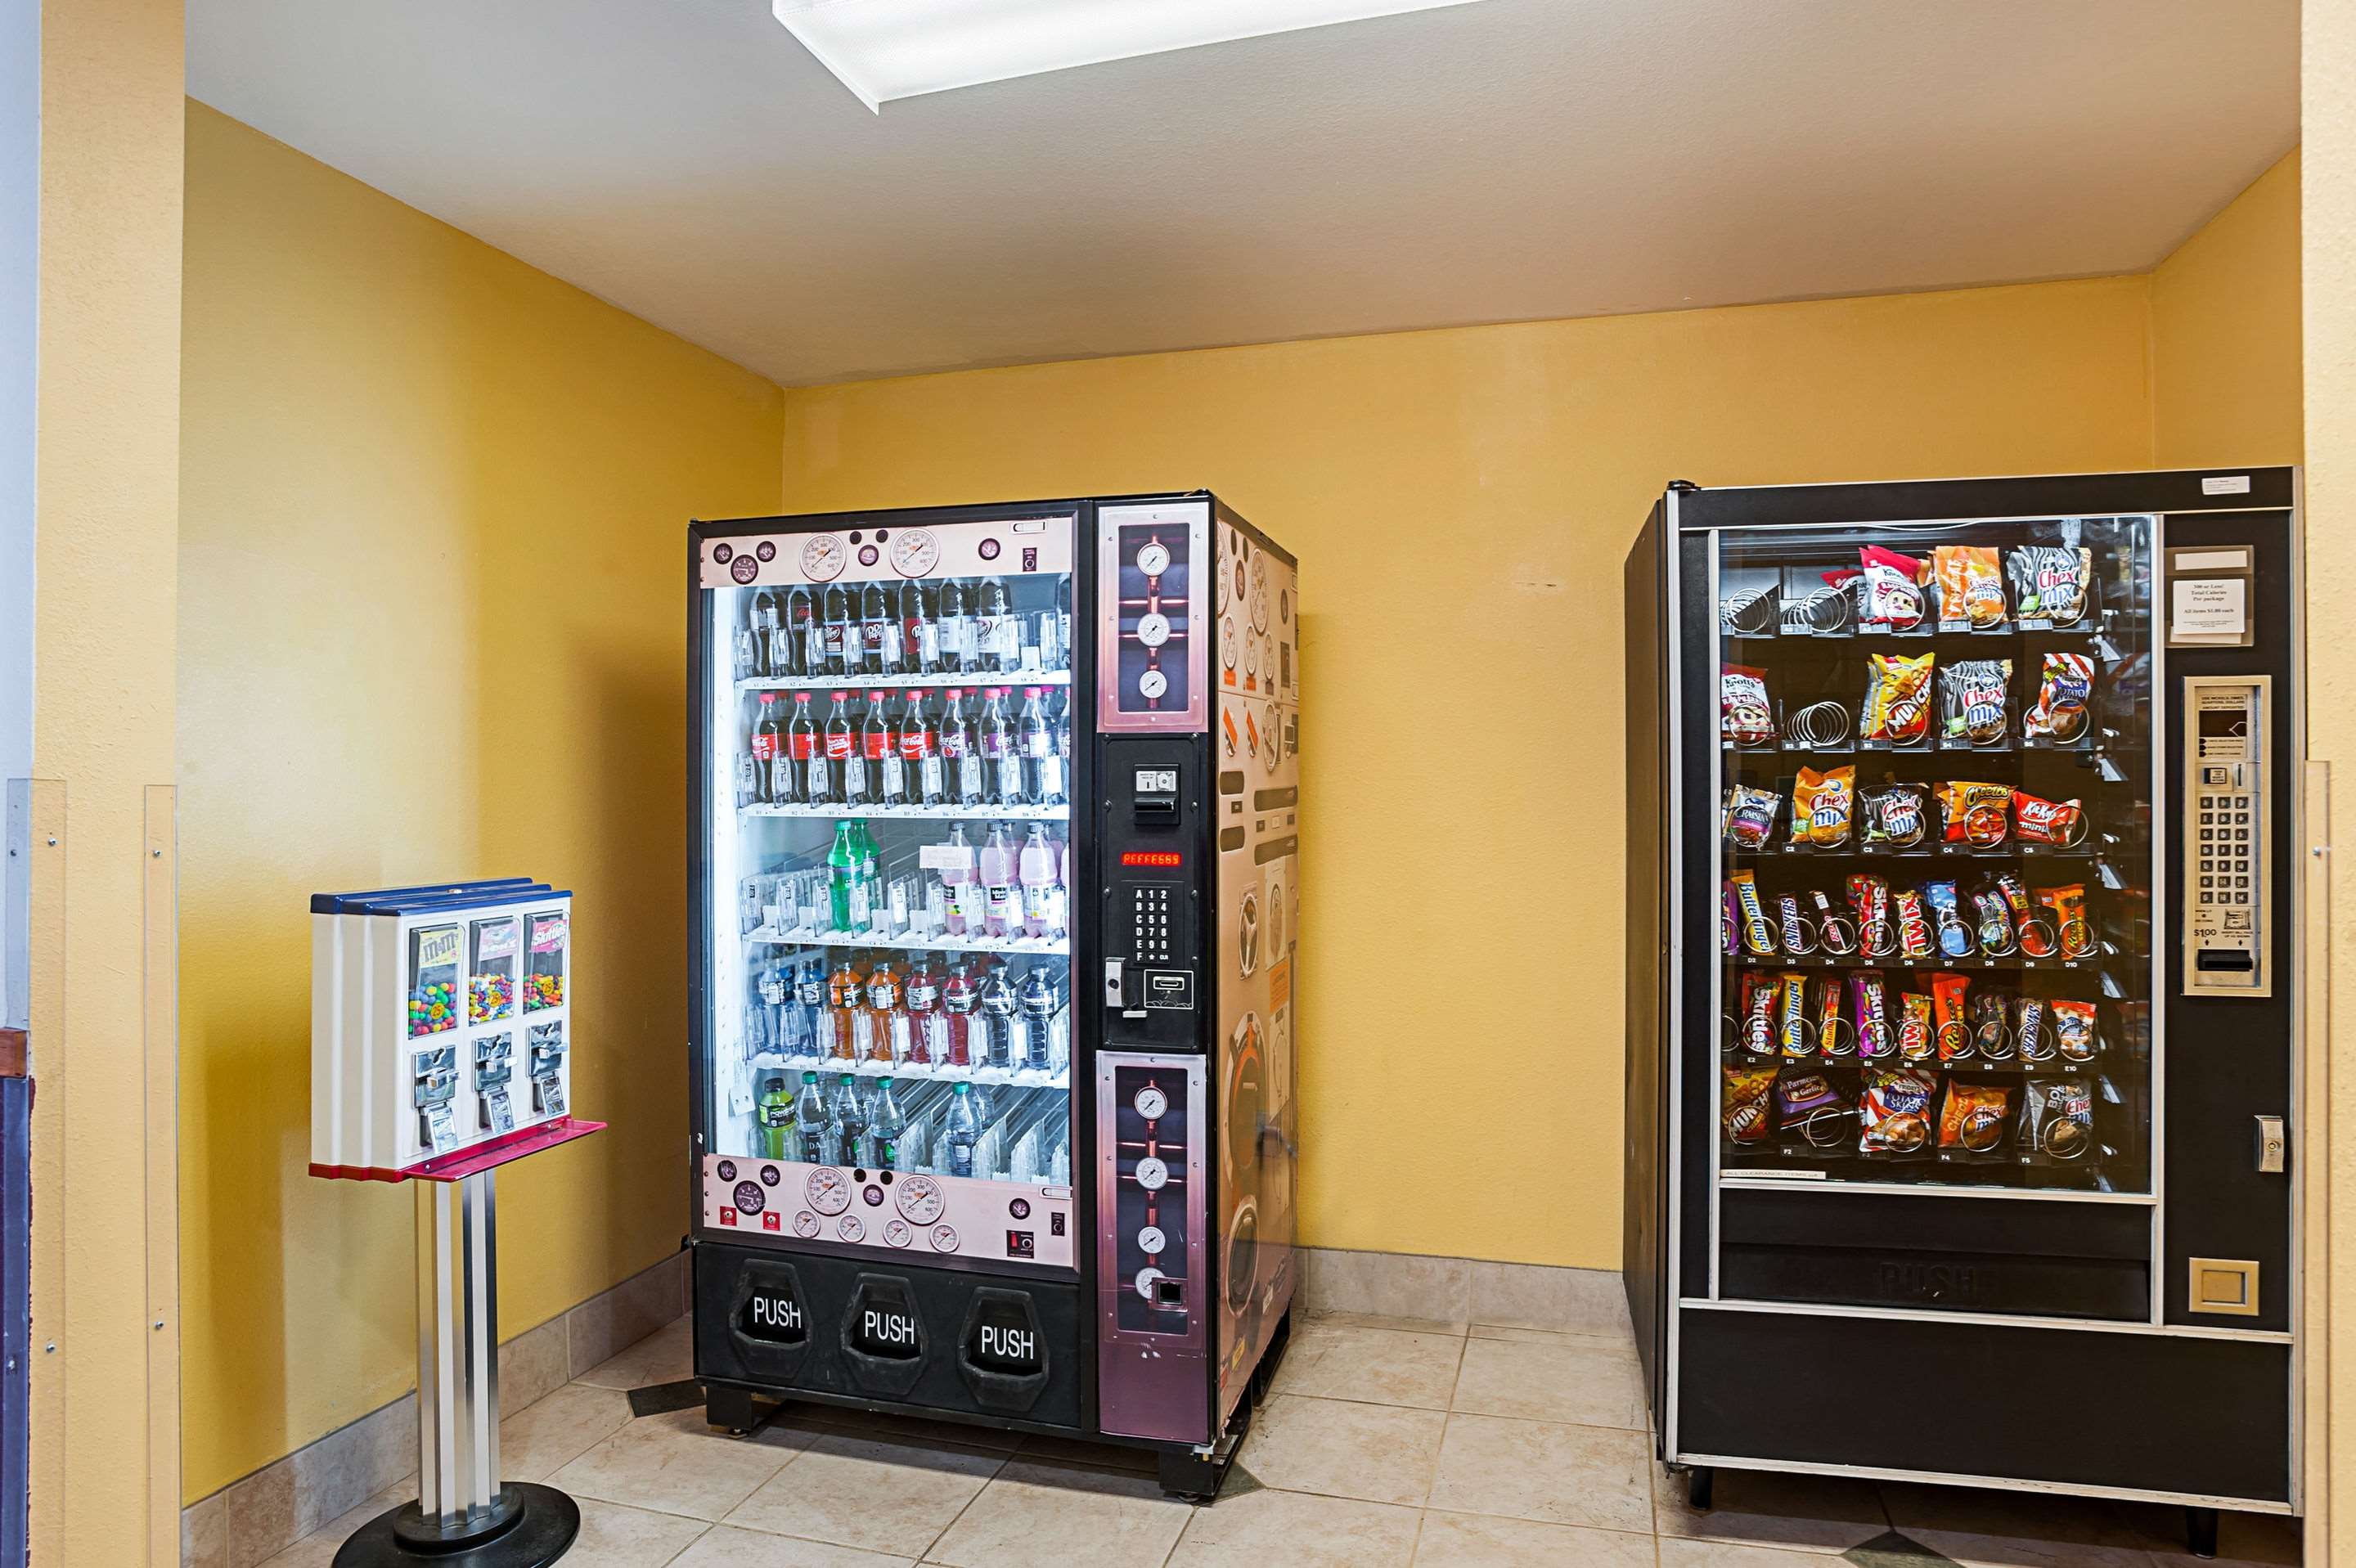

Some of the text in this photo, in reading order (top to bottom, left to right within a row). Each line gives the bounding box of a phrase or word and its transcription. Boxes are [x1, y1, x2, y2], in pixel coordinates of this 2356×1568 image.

[2038, 568, 2079, 589] Chex
[1964, 685, 2004, 708] Chex
[1968, 704, 2003, 725] mix
[1809, 791, 1849, 812] Chex
[1964, 784, 2010, 808] Cheetos
[1814, 810, 1848, 828] mix
[1135, 890, 1142, 899] A
[1149, 890, 1154, 898] 1
[1160, 890, 1167, 899] 2
[1135, 902, 1142, 911] B
[1149, 903, 1154, 911] 3
[1160, 903, 1167, 911] 4
[1135, 914, 1142, 924] C
[1149, 914, 1154, 924] 5
[1160, 914, 1167, 924] 6
[1782, 897, 1801, 951] SNICKERS
[1904, 896, 1926, 953] TWIX
[1135, 928, 1143, 937] D
[1149, 928, 1155, 937] 7
[1161, 928, 1167, 937] 8
[1136, 940, 1142, 949] E
[1149, 941, 1155, 949] 9
[1161, 941, 1167, 949] 0
[1136, 952, 1142, 961] F
[1866, 983, 1886, 1052] Skittles
[2022, 1004, 2042, 1058] SNICKERS
[1800, 1086, 1821, 1099] Garlic
[1972, 1104, 2003, 1121] Chex
[1880, 1262, 1977, 1299] PUSH
[753, 1296, 802, 1328] PUSH
[864, 1310, 915, 1345] PUSH
[981, 1325, 1034, 1359] PUSH
